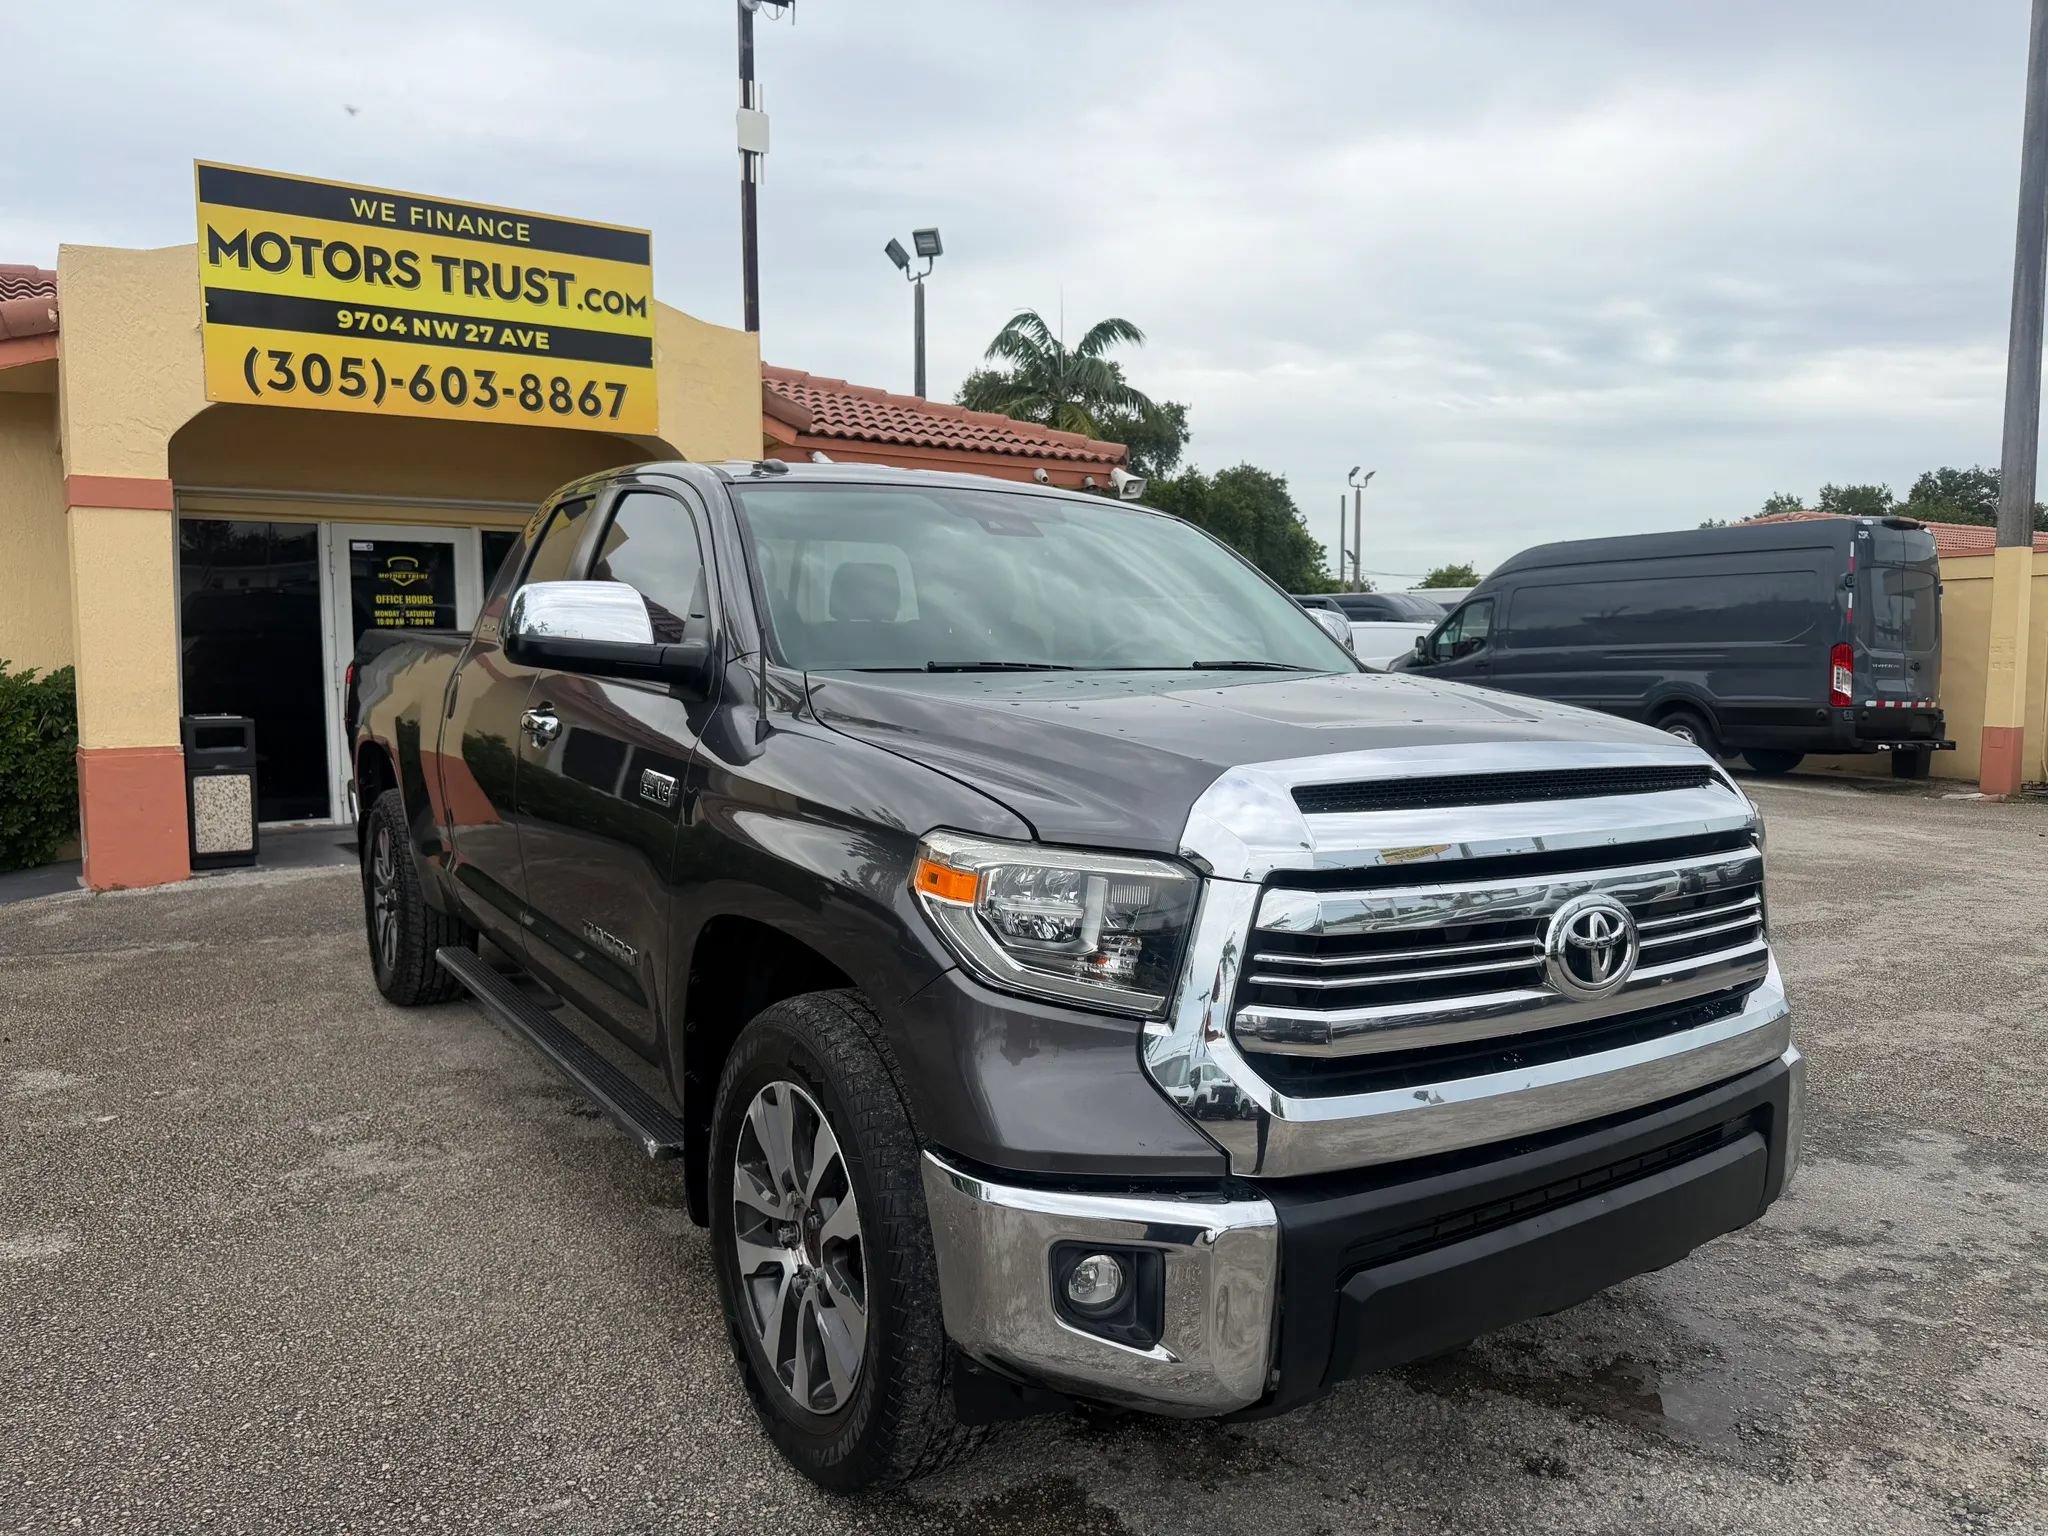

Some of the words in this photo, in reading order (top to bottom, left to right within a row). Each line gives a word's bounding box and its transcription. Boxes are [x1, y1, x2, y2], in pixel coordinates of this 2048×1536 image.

[350, 196, 397, 224] WE
[409, 205, 531, 243] FINANCE
[206, 222, 422, 290] MOTORS
[336, 308, 408, 336] 9704
[412, 320, 460, 341] NW
[464, 324, 495, 346] 27
[498, 330, 550, 350] AVE
[242, 344, 628, 420] (305)-603-8867
[375, 594, 404, 604] OFFICE
[404, 595, 433, 605] HOURS
[405, 610, 436, 618] SATURDAY
